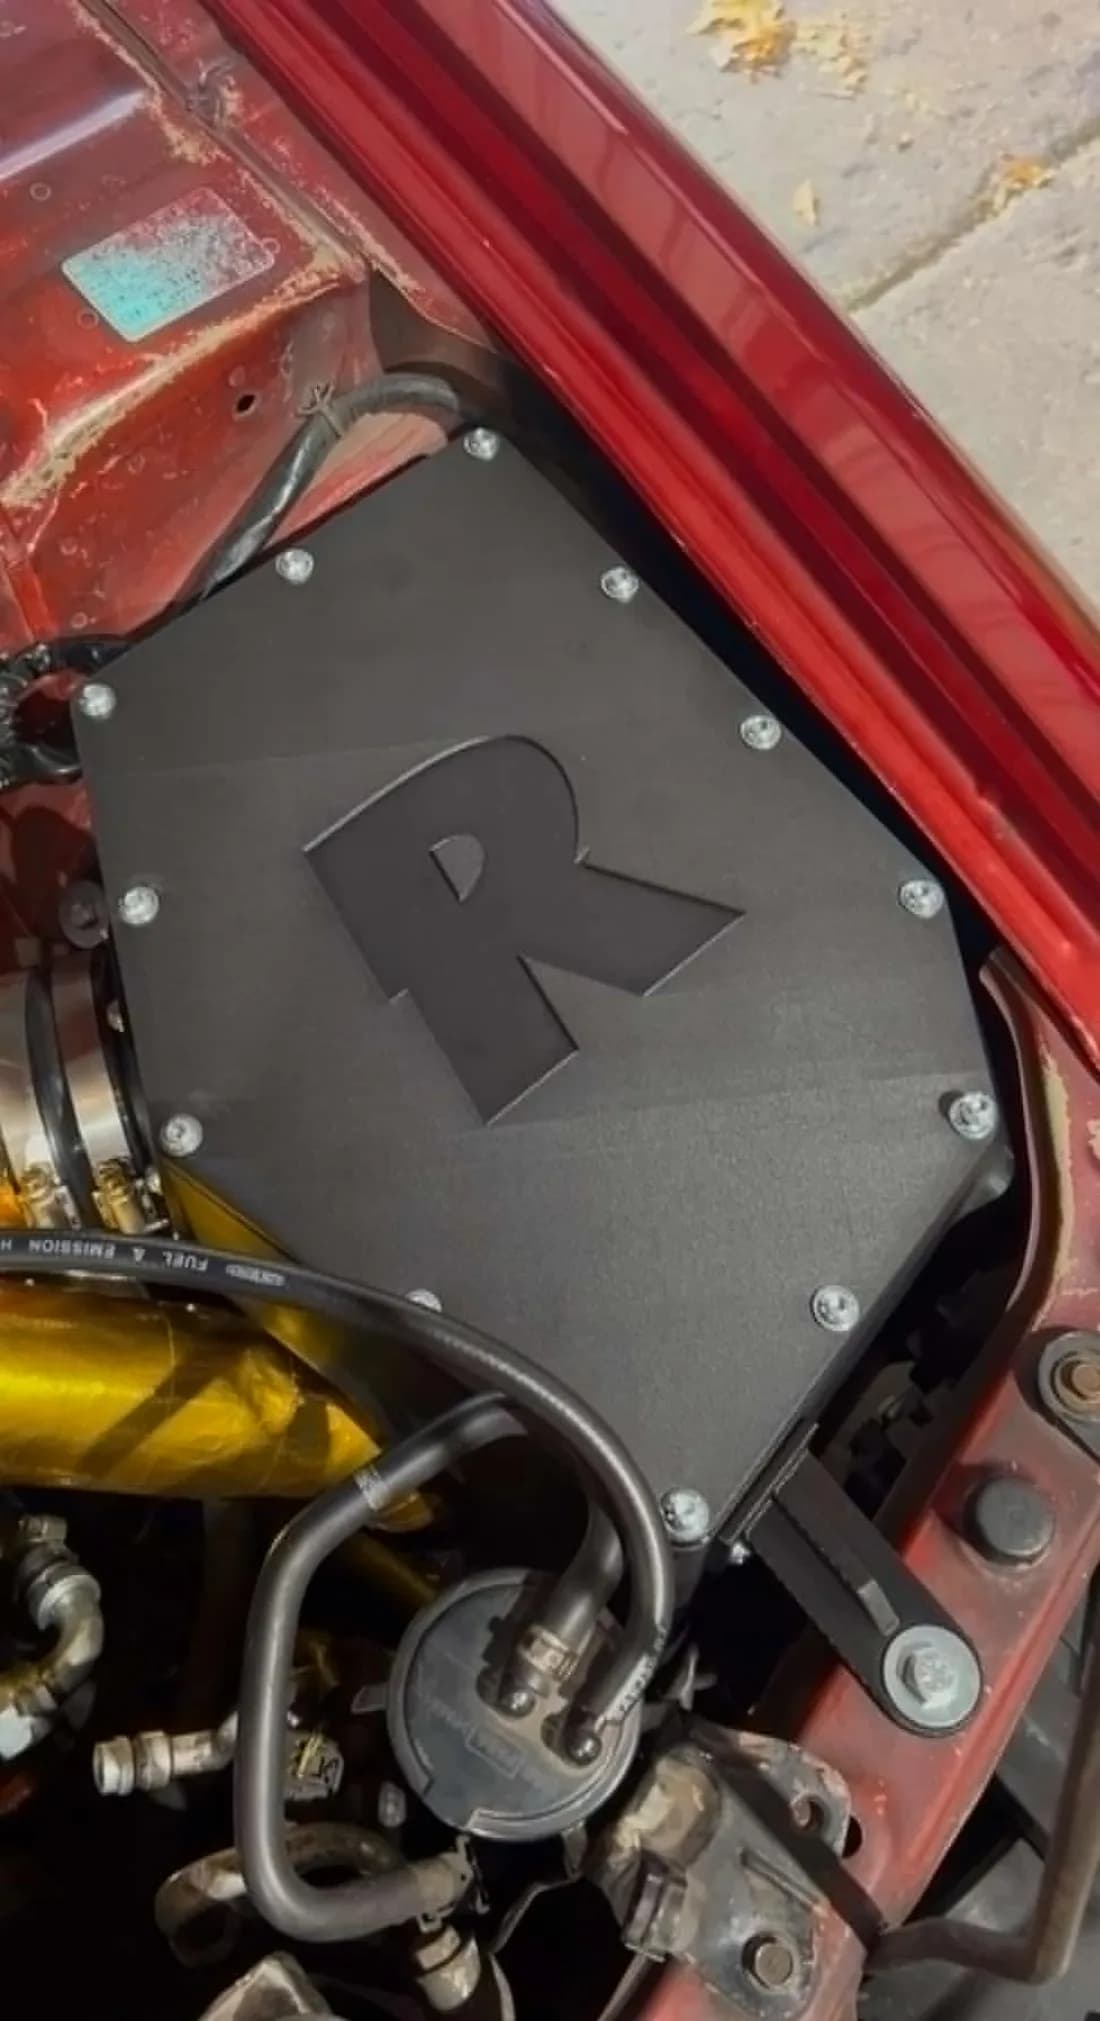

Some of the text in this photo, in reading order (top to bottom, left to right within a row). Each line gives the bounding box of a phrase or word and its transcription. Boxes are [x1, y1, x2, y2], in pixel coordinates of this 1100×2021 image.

[303, 734, 747, 1127] R
[29, 1240, 116, 1259] EMISSION
[132, 1247, 144, 1263] &
[163, 1252, 209, 1272] FUEL
